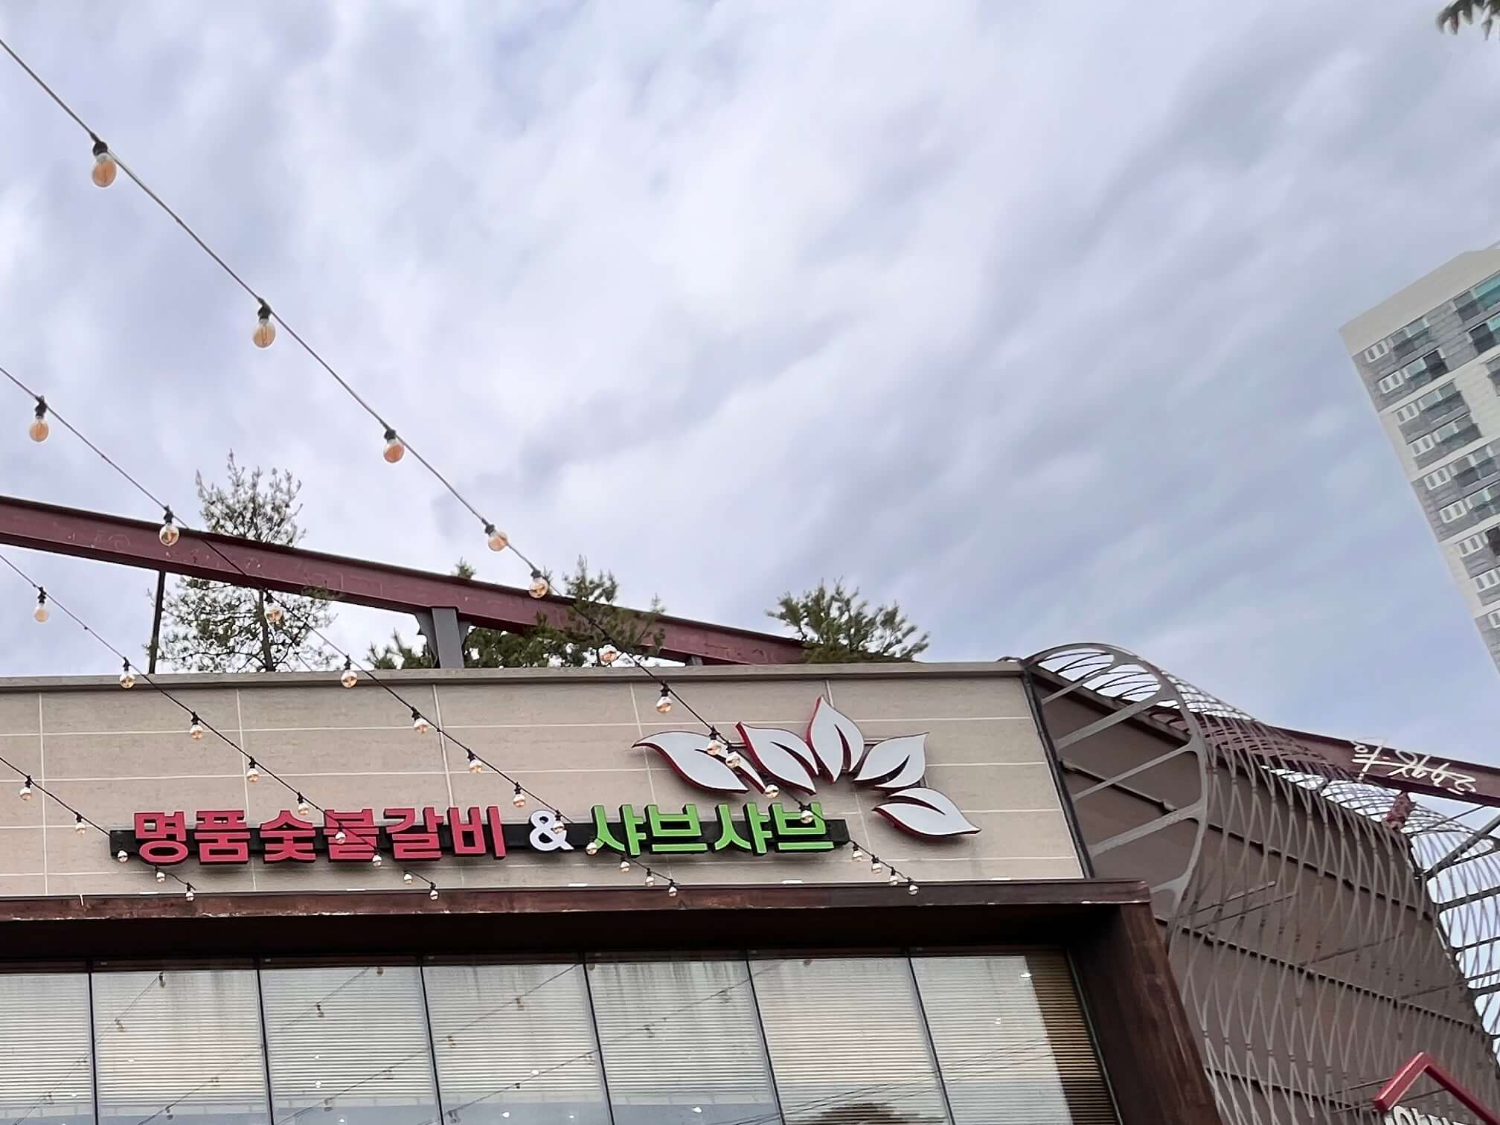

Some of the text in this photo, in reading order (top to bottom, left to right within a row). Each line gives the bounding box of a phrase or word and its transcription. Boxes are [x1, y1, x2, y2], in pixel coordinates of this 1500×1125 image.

[133, 801, 835, 864] 명품숯불갈비 & 샤브샤브
